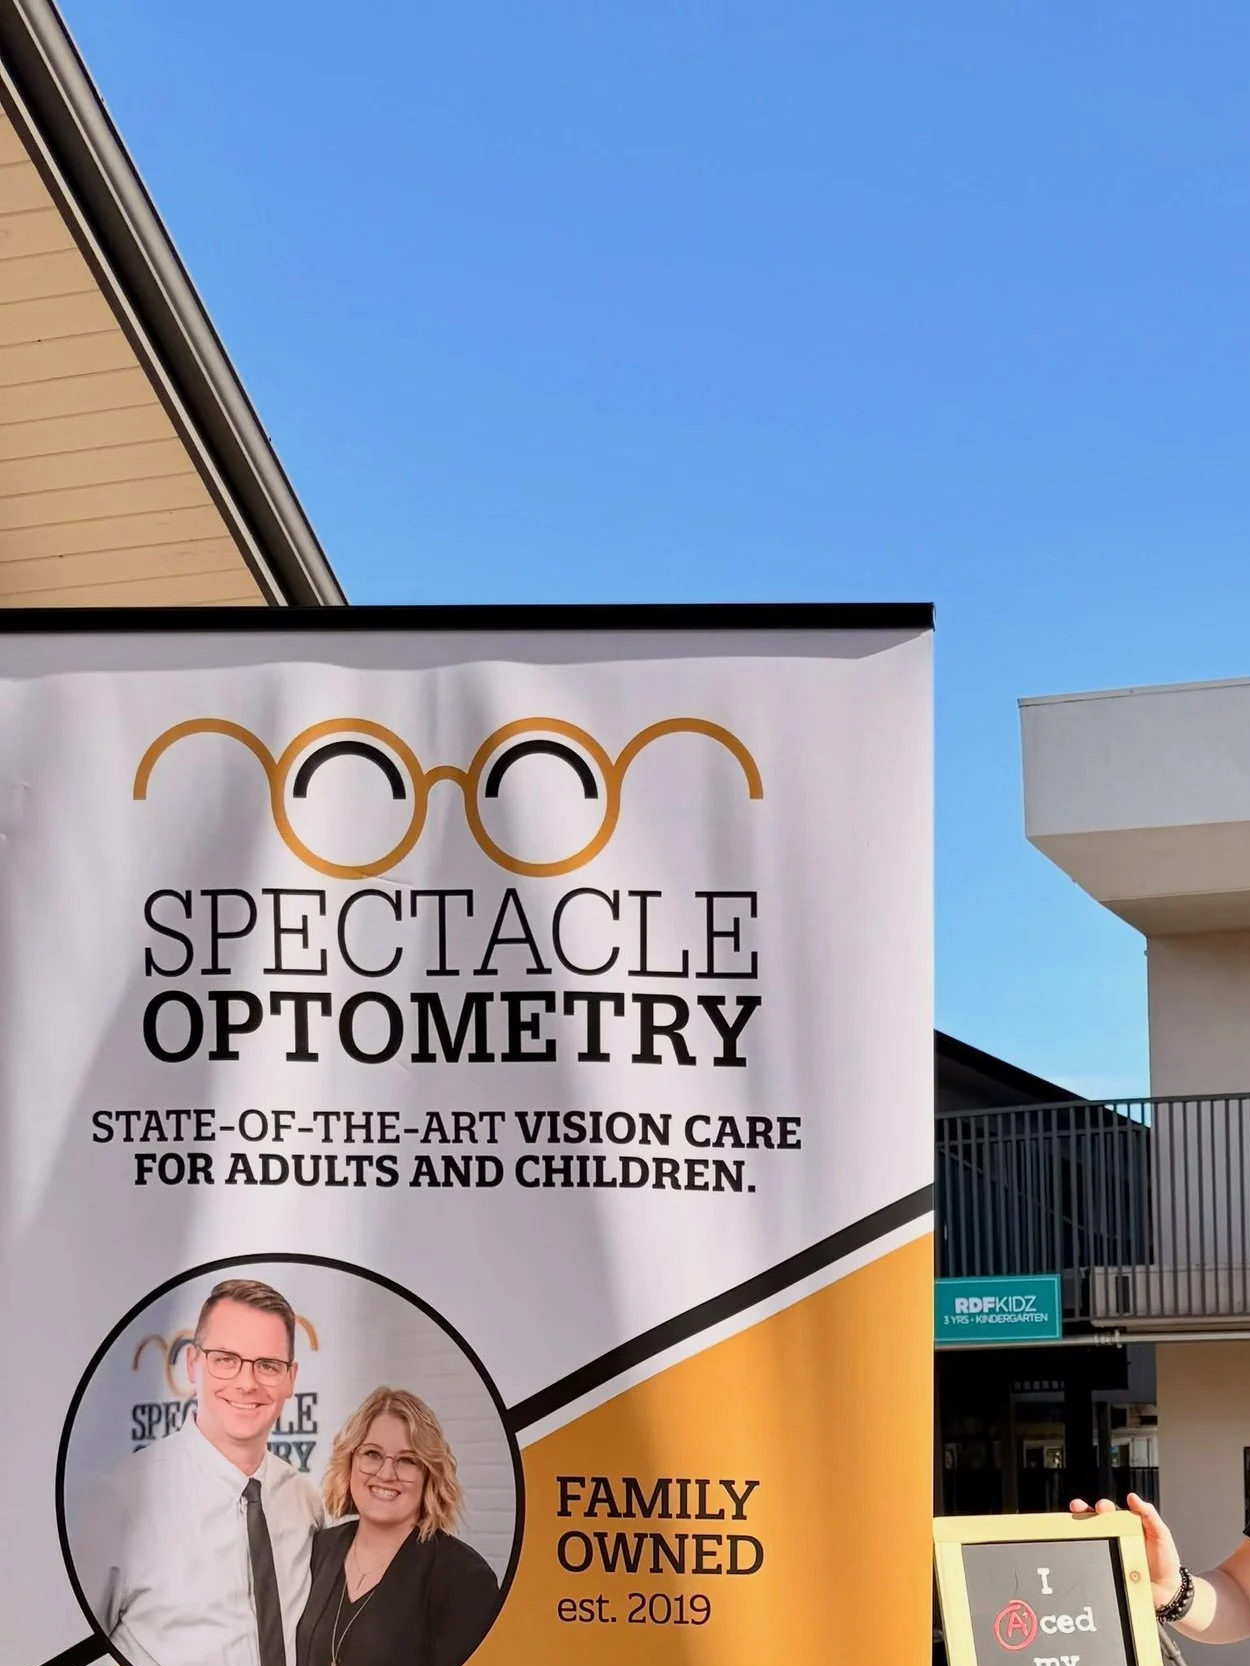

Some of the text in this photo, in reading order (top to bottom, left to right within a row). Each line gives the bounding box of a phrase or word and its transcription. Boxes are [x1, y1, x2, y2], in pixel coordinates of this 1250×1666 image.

[144, 888, 757, 979] SPECTACLE
[144, 991, 761, 1067] OPTOMETRY
[93, 1109, 801, 1149] STATE-OF-THE-ART VISION CARE
[135, 1153, 755, 1192] FOR ADULTS AND CHILDREN.
[944, 1316, 950, 1325] 3
[951, 1315, 969, 1324] YRS
[976, 1313, 1048, 1323] KINDERGARTEN
[955, 1295, 1037, 1313] RDFKIDZ
[557, 1477, 760, 1520] FAMILY
[558, 1531, 763, 1575] OWNED
[1036, 1567, 1053, 1595] I
[558, 1593, 710, 1625] est. 2019
